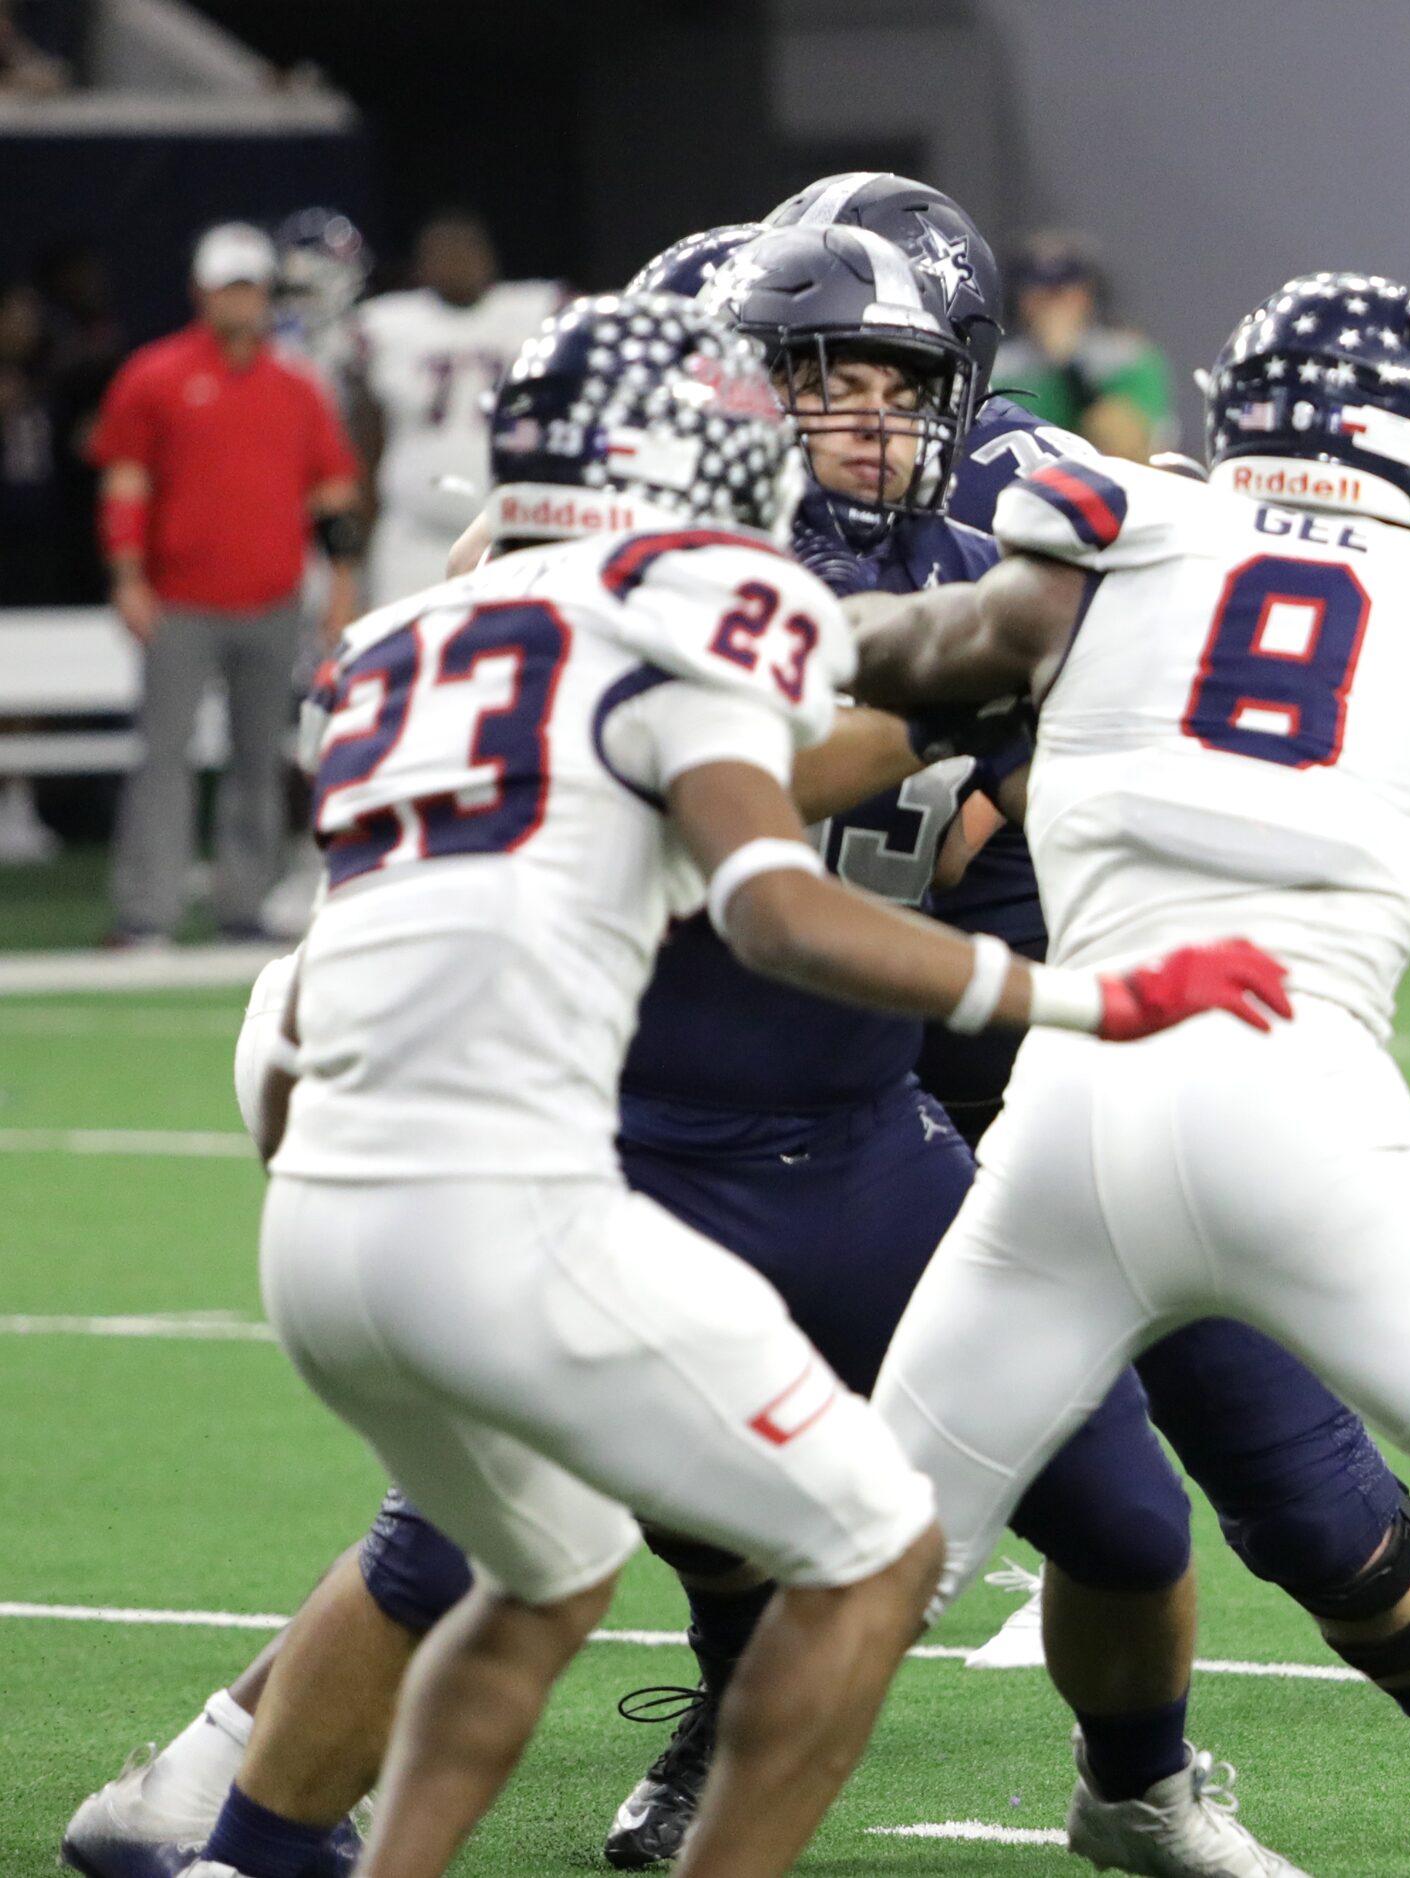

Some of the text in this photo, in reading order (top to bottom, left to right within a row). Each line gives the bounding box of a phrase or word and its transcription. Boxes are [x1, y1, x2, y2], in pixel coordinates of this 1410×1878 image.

[500, 495, 634, 531] Riddell
[1233, 465, 1362, 502] Riddell
[1253, 504, 1368, 553] GEE
[707, 578, 820, 706] 23
[1181, 552, 1372, 771] 8
[316, 597, 573, 893] 23
